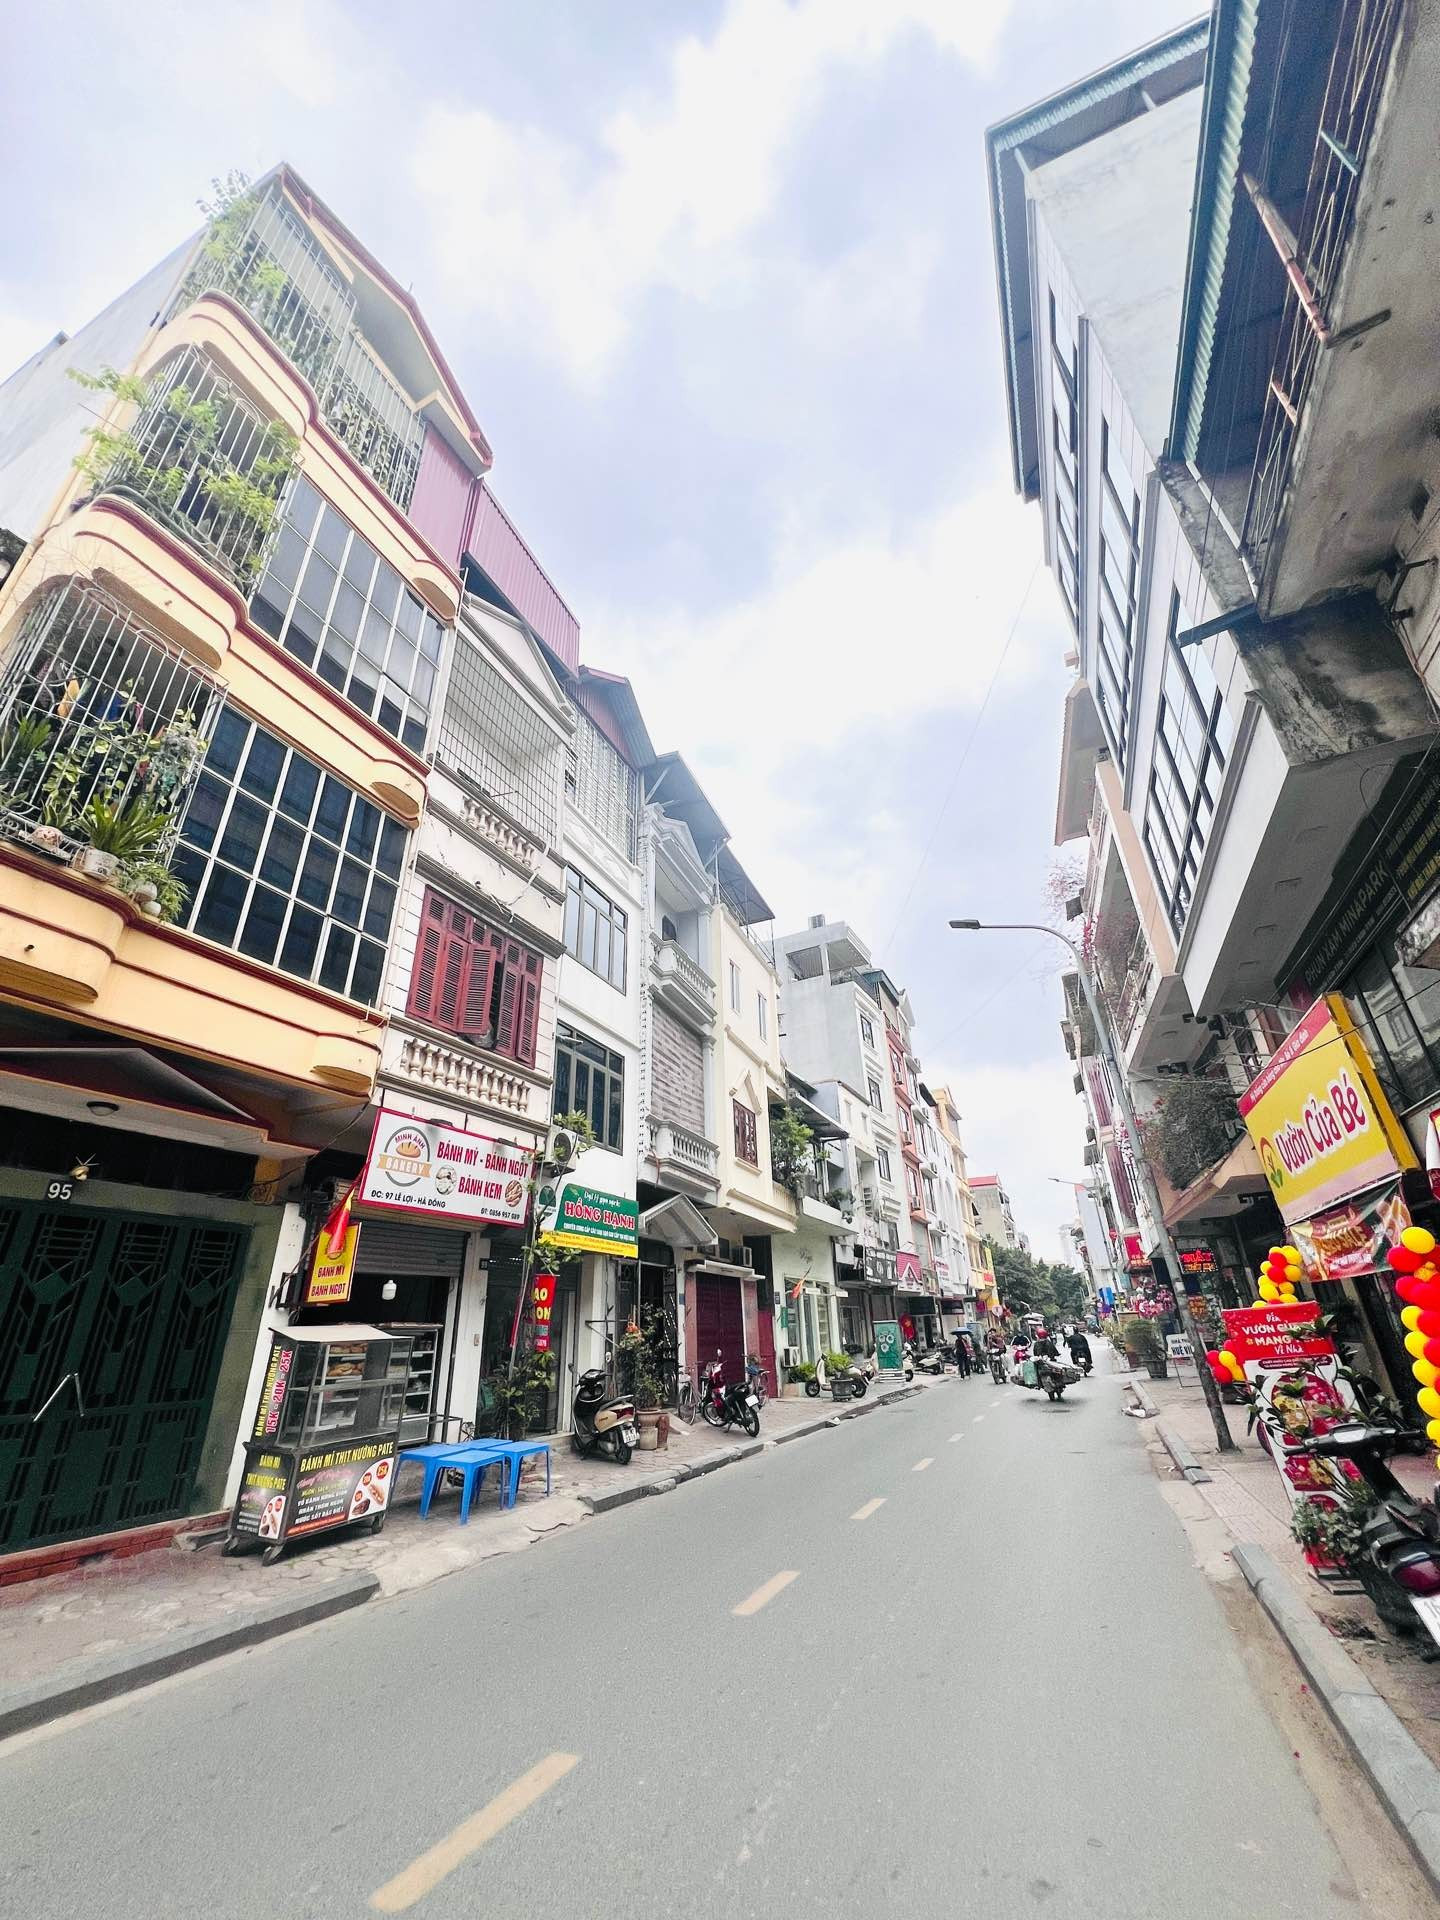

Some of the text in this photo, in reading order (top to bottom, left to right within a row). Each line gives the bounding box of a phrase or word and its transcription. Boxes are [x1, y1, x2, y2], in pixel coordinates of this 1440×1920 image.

[1275, 1073, 1365, 1173] Vườn Của Bé
[395, 1133, 412, 1143] MINH
[385, 1157, 425, 1175] BAKERY
[437, 1140, 463, 1163] BÁNH
[485, 1152, 507, 1173] BÁNH
[508, 1159, 528, 1180] NGỌT
[47, 1182, 73, 1200] 95
[458, 1174, 503, 1200] BÁNH KEM
[385, 1192, 393, 1200] 97
[402, 1194, 413, 1204] LỢI
[417, 1196, 427, 1205] HÀ
[428, 1198, 446, 1208] ĐÔNG
[565, 1197, 635, 1230] HỒNG HẠNH
[1242, 1322, 1276, 1335] VƯỜN
[1255, 1335, 1292, 1346] MANG
[1286, 1344, 1304, 1354] Nhà
[272, 1345, 282, 1363] PATE
[279, 1350, 292, 1373] 25K
[272, 1380, 286, 1404] 20K
[266, 1411, 279, 1433] 15K
[300, 1455, 324, 1472] BÁNH
[335, 1450, 352, 1466] THỊT
[352, 1444, 377, 1460] NƯỚNG
[377, 1442, 394, 1456] PATE
[273, 1478, 286, 1490] PATE
